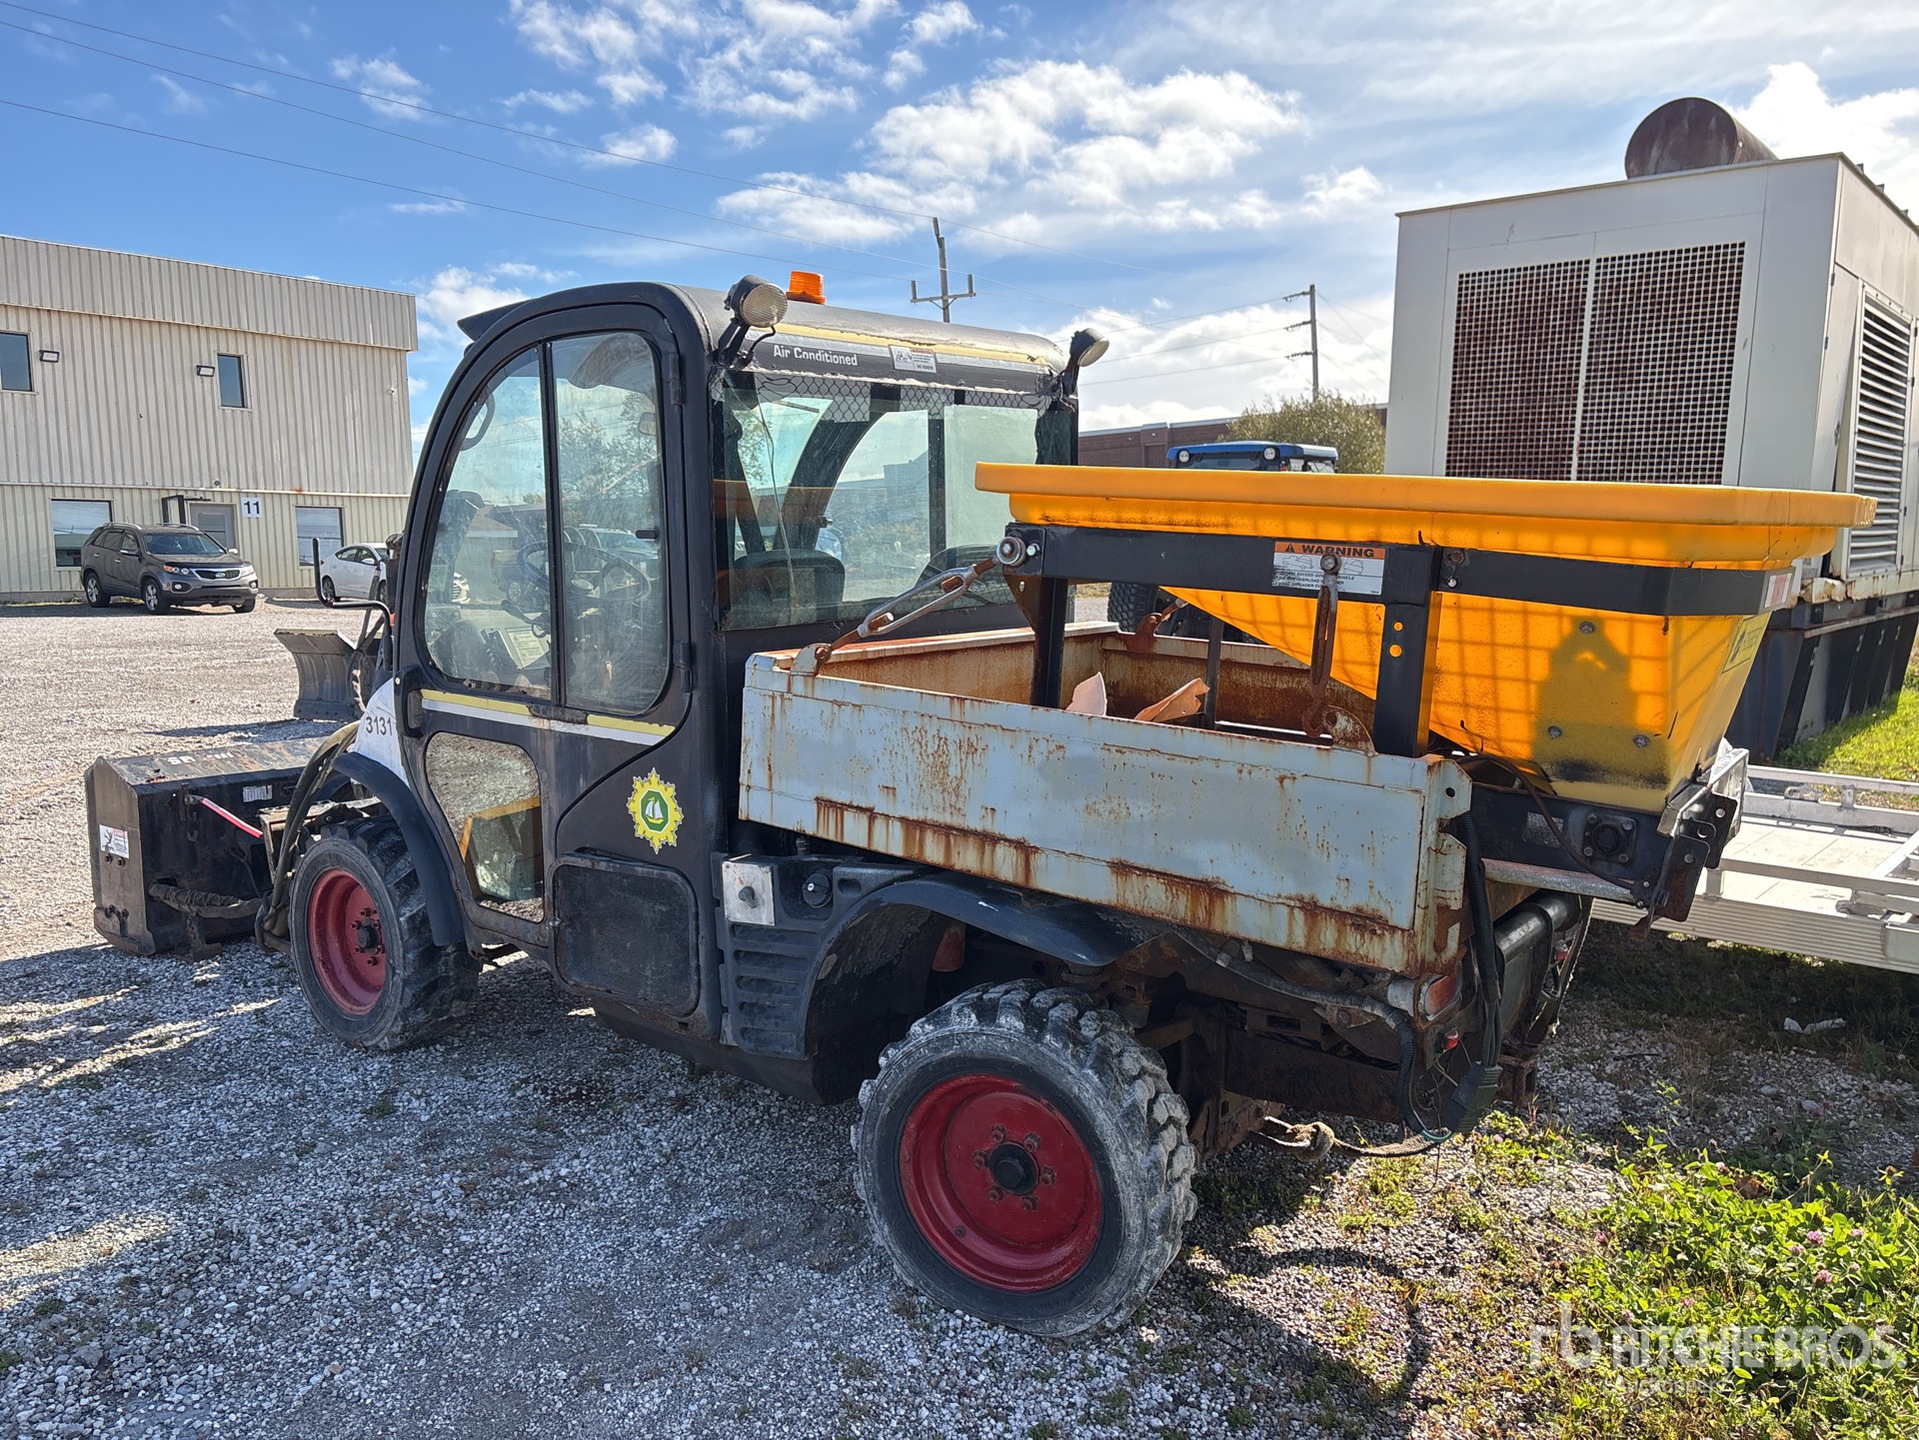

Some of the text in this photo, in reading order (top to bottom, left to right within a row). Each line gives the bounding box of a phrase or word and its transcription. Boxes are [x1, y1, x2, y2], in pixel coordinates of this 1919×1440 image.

[773, 344, 858, 366] Air Conditioned
[244, 500, 260, 515] 11
[1301, 544, 1375, 558] WARNING
[365, 716, 393, 736] 3131
